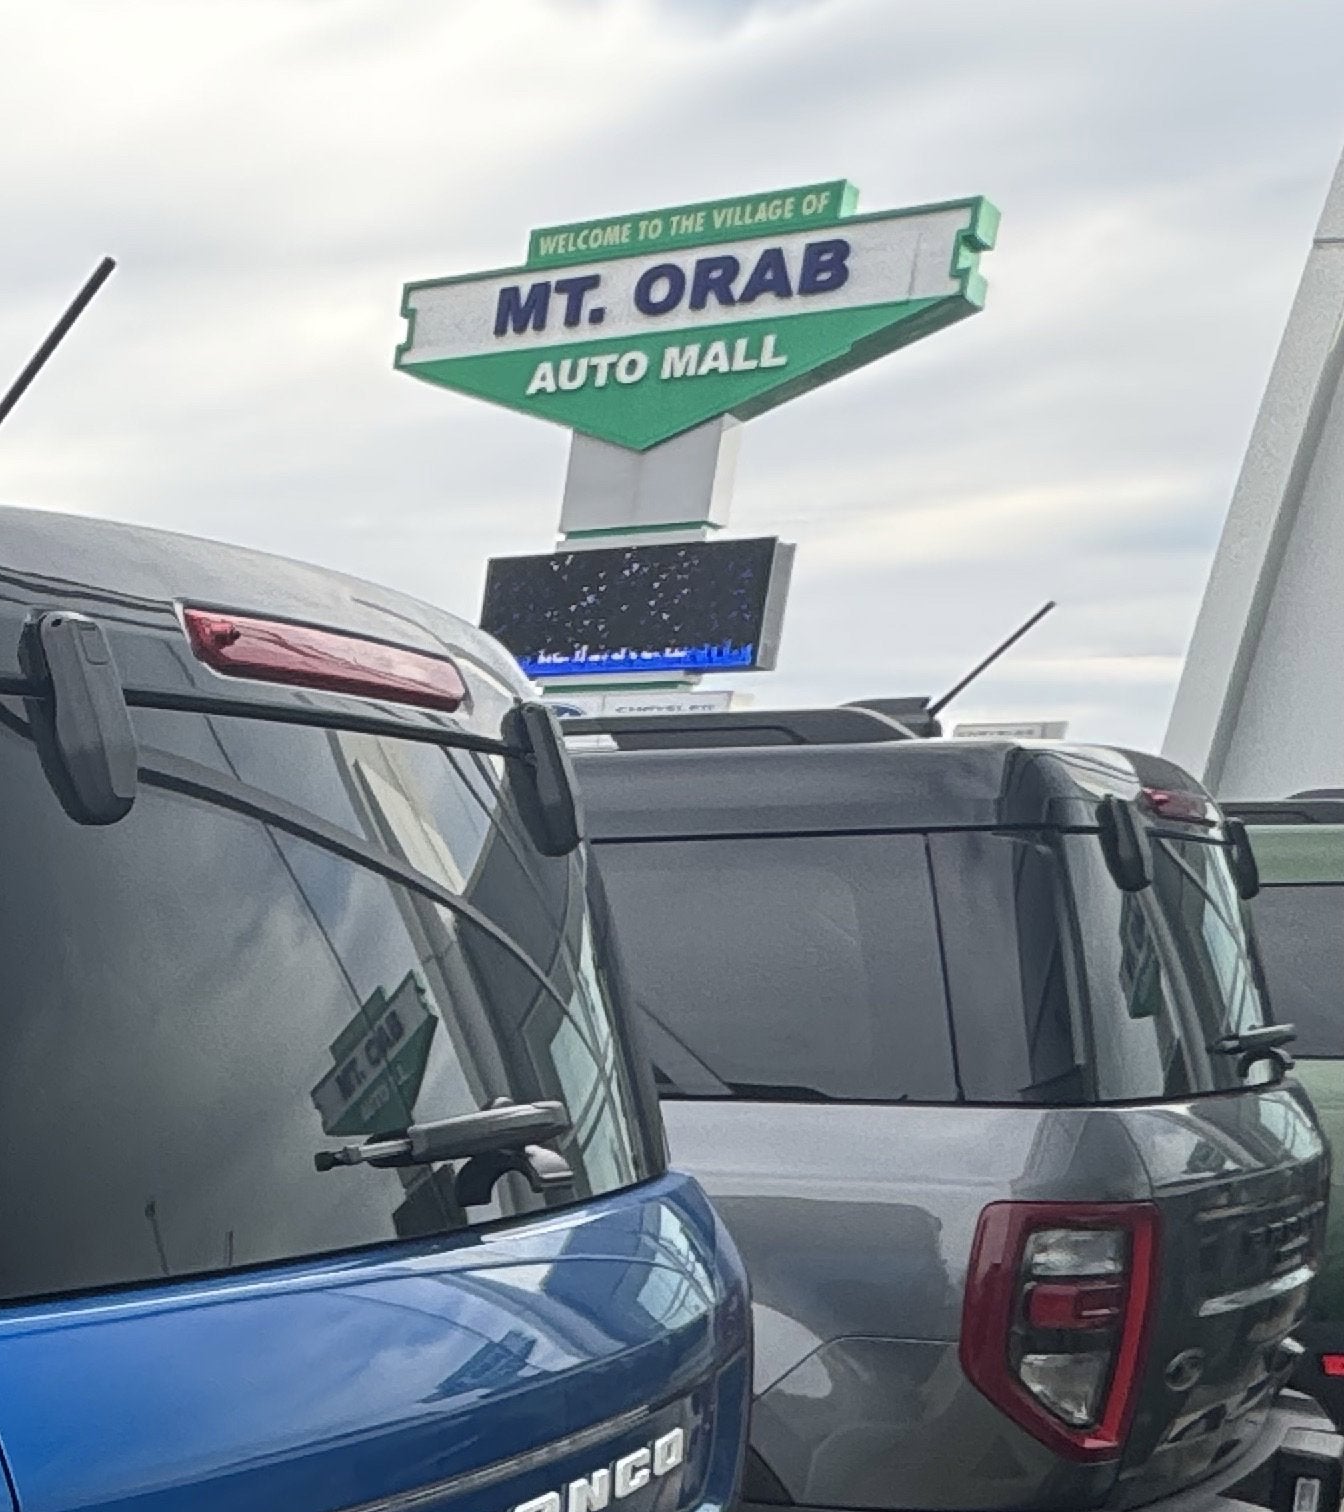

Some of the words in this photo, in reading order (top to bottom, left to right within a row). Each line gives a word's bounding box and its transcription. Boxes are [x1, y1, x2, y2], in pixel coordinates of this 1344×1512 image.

[539, 222, 631, 256] WELCOME
[638, 218, 662, 241] TO
[670, 211, 705, 236] THE
[712, 196, 795, 229] VILLAGE
[801, 191, 831, 216] OF
[493, 274, 607, 338] MT.
[633, 238, 852, 316] ORAB
[525, 350, 650, 396] AUTO
[661, 334, 789, 380] MALL
